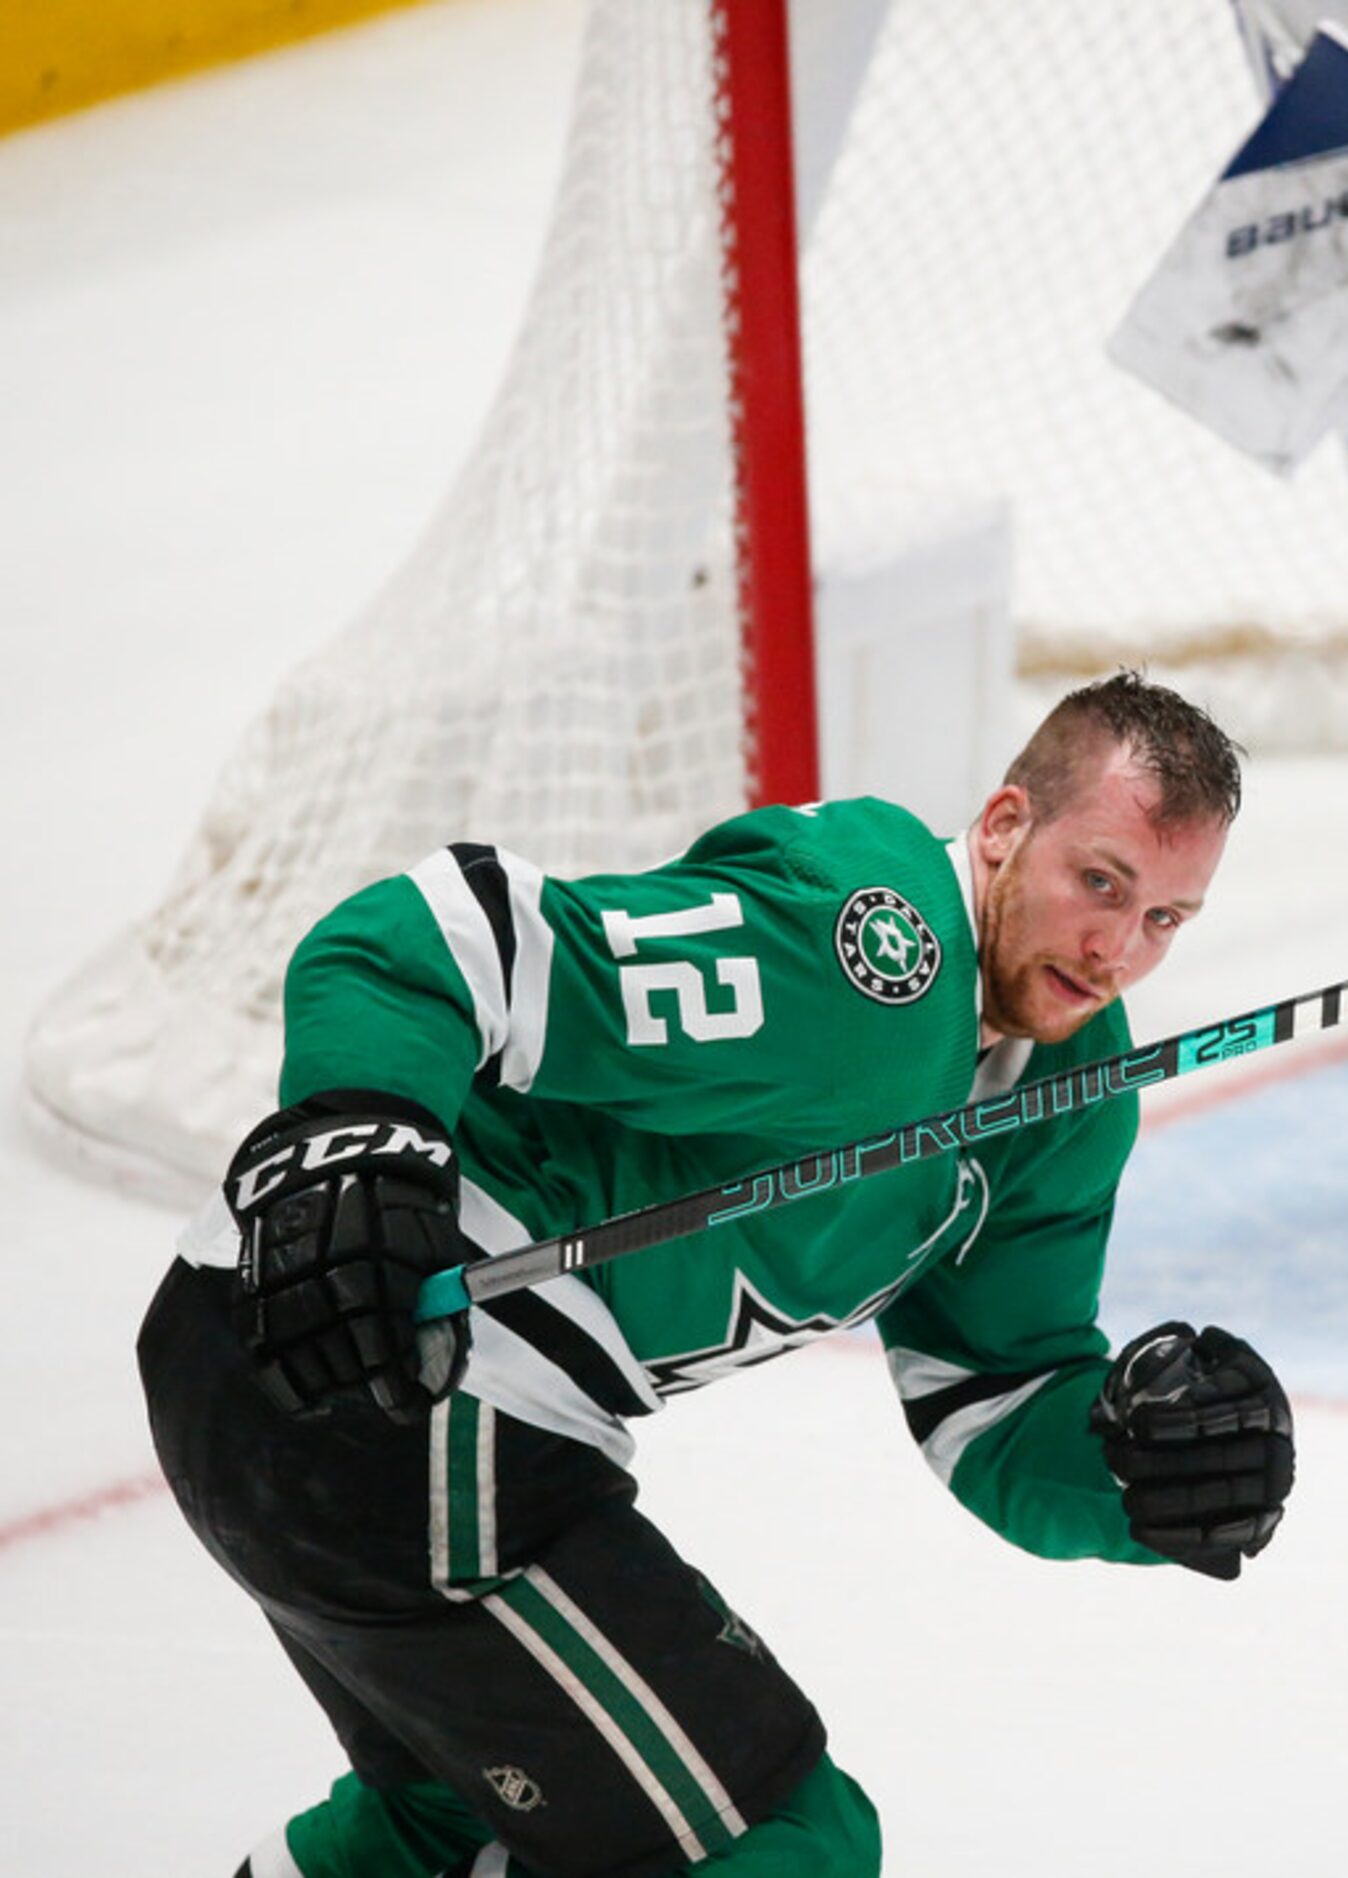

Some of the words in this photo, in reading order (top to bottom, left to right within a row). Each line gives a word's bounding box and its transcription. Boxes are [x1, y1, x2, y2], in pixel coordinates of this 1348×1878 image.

[600, 892, 765, 1047] 12
[1194, 1016, 1258, 1066] 25
[235, 1122, 452, 1212] CCM
